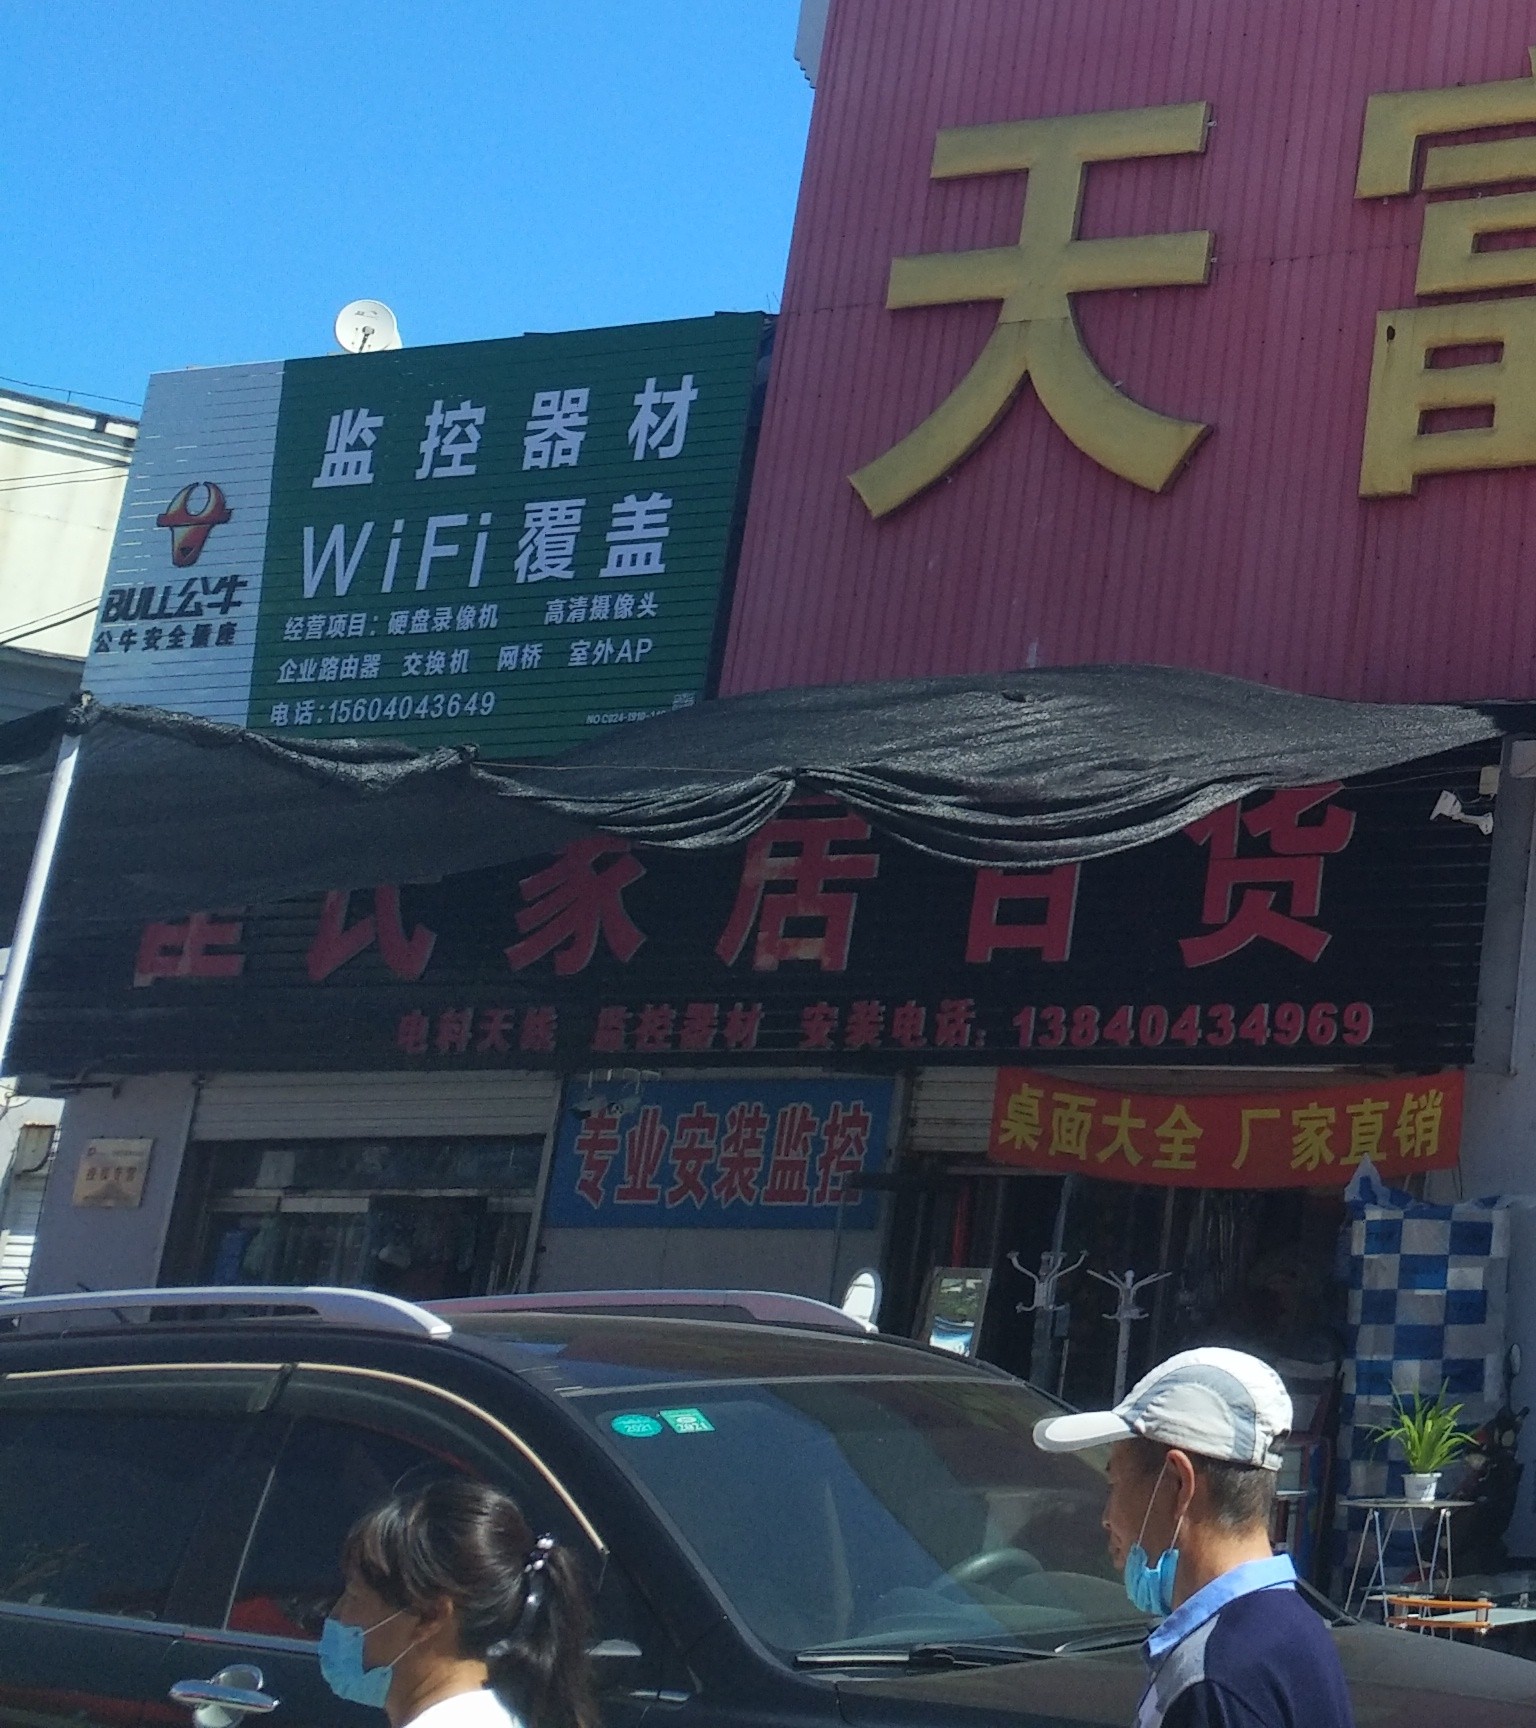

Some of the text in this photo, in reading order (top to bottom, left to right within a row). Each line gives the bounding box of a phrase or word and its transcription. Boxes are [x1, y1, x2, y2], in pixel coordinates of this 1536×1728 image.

[312, 374, 699, 489] 监控器材
[544, 592, 659, 625] 高清摄像头
[276, 637, 653, 684] 企业路由器 交换机 网桥 室外AP
[590, 1002, 765, 1053] 监控器材
[1013, 1002, 1374, 1048] 13840434969
[574, 1101, 872, 1209] 专业安装监控
[999, 1082, 1446, 1172] 桌面大全 厂家直销
